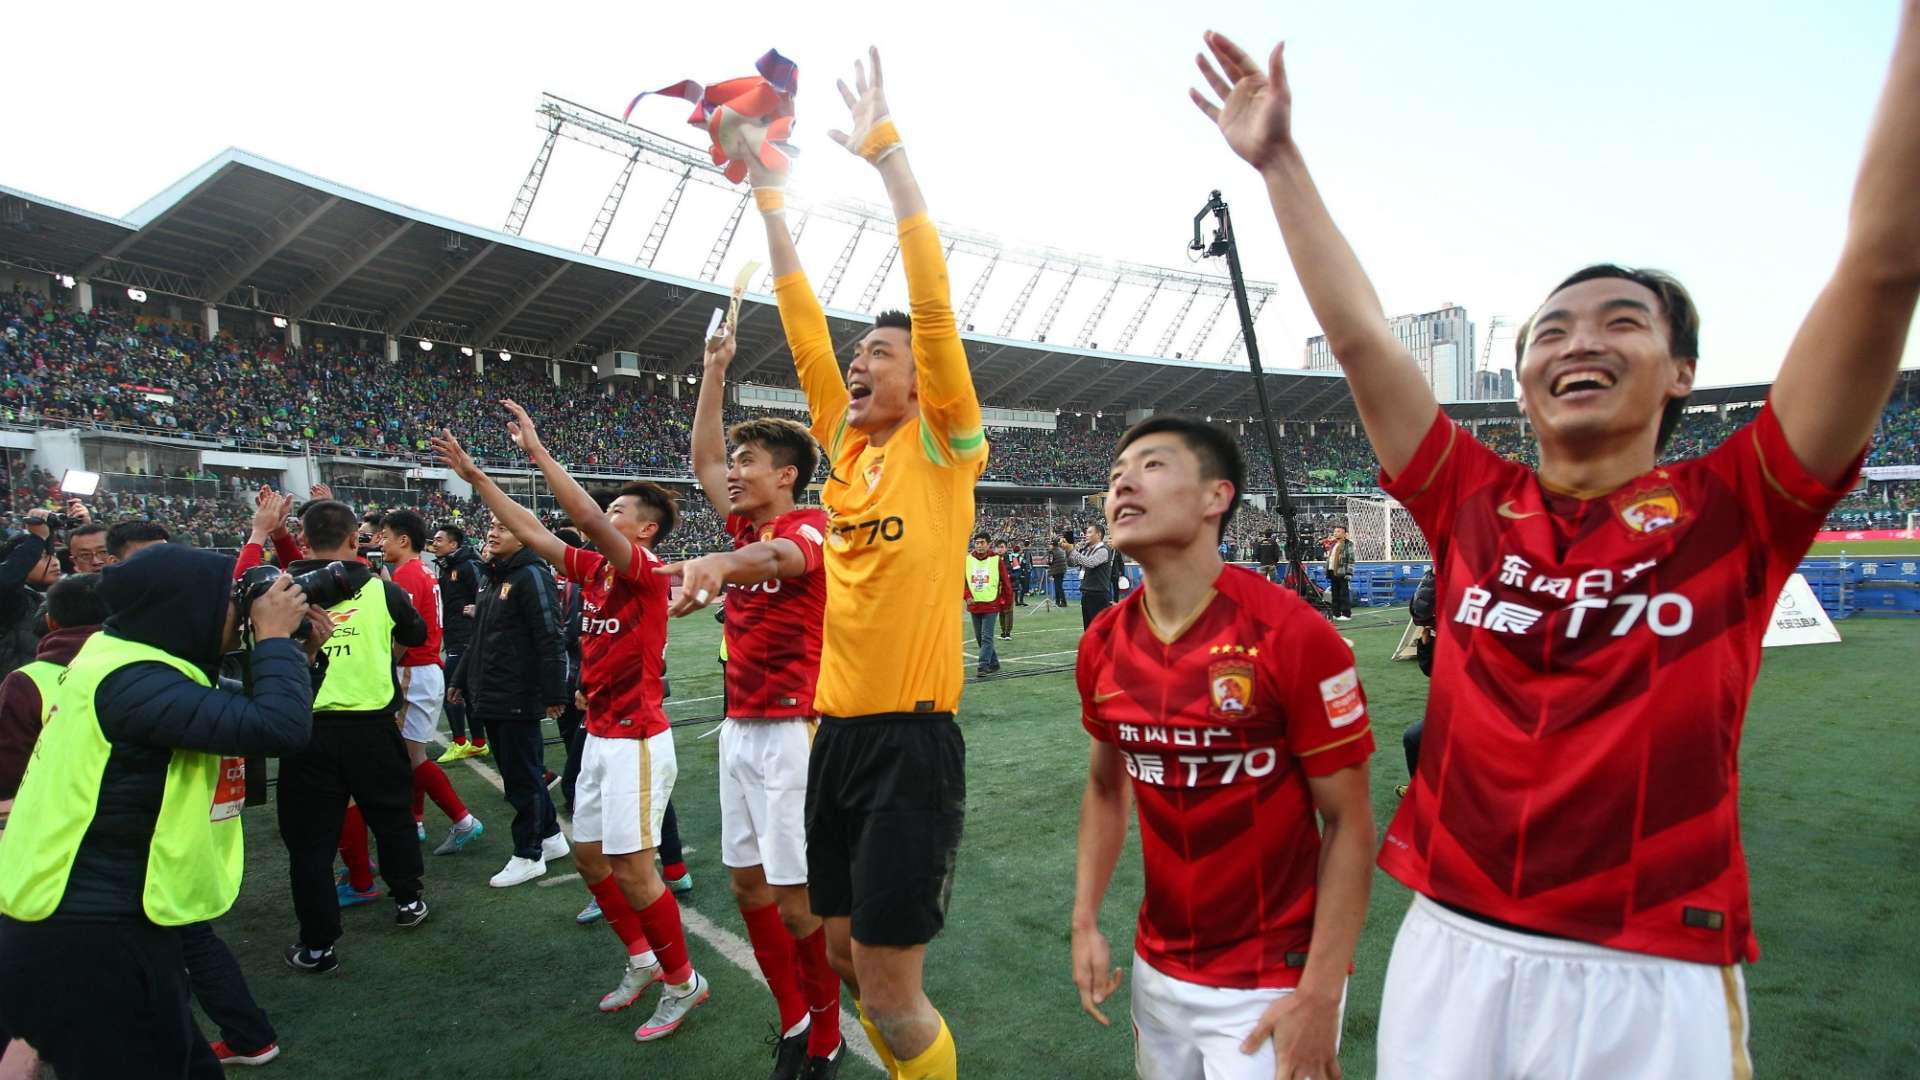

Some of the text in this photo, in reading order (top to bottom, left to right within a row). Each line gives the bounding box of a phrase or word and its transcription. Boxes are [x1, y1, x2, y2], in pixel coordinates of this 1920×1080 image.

[1454, 584, 1694, 639] 启辰 T70
[1178, 747, 1276, 788] T70
